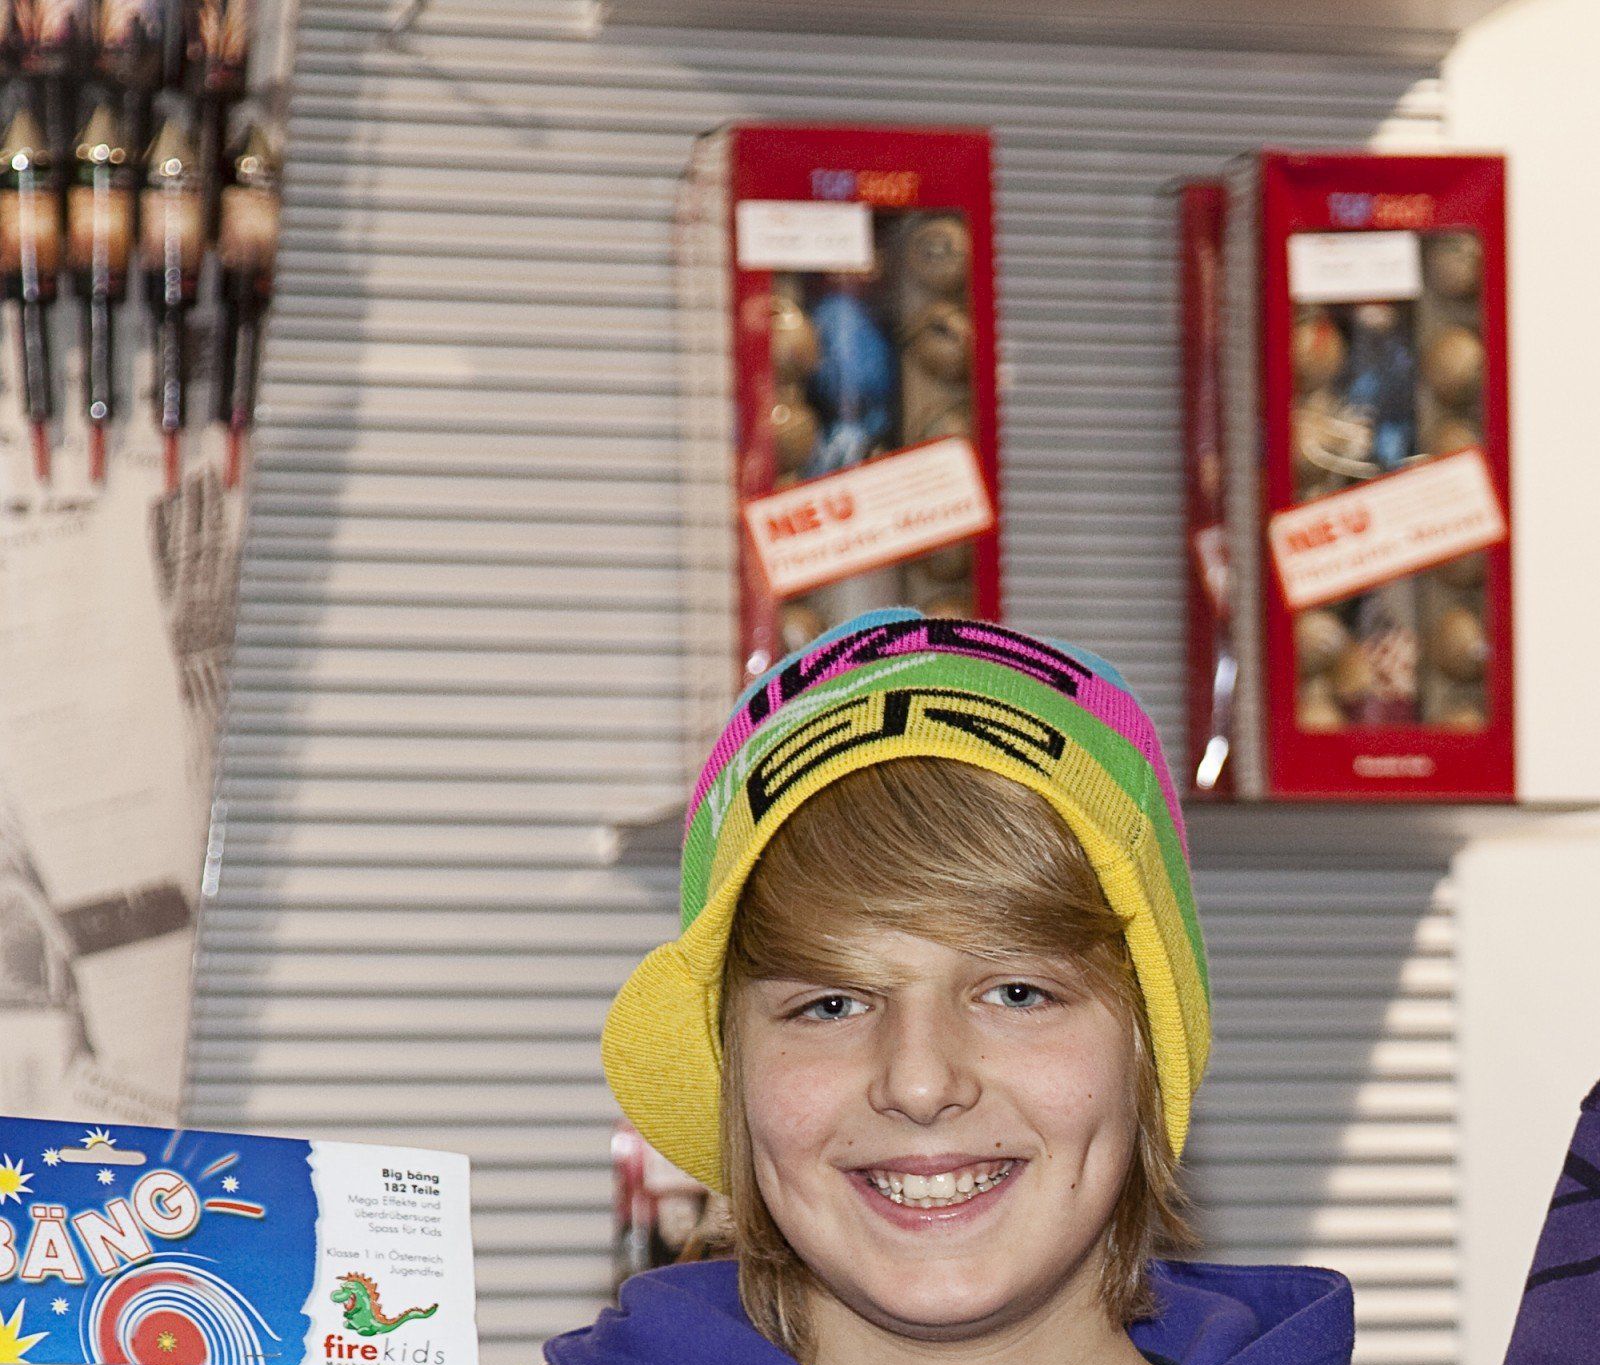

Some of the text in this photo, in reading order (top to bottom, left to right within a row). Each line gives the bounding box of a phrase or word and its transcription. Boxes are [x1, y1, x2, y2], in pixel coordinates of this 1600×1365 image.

[382, 1168, 402, 1181] Big
[384, 1182, 440, 1196] 182 Teile
[347, 1195, 441, 1209] Mega Effekte und
[368, 1223, 442, 1237] Spass für Kids
[326, 1248, 444, 1264] Klasse 1 in Österreich
[389, 1265, 444, 1277] Jugendfrei
